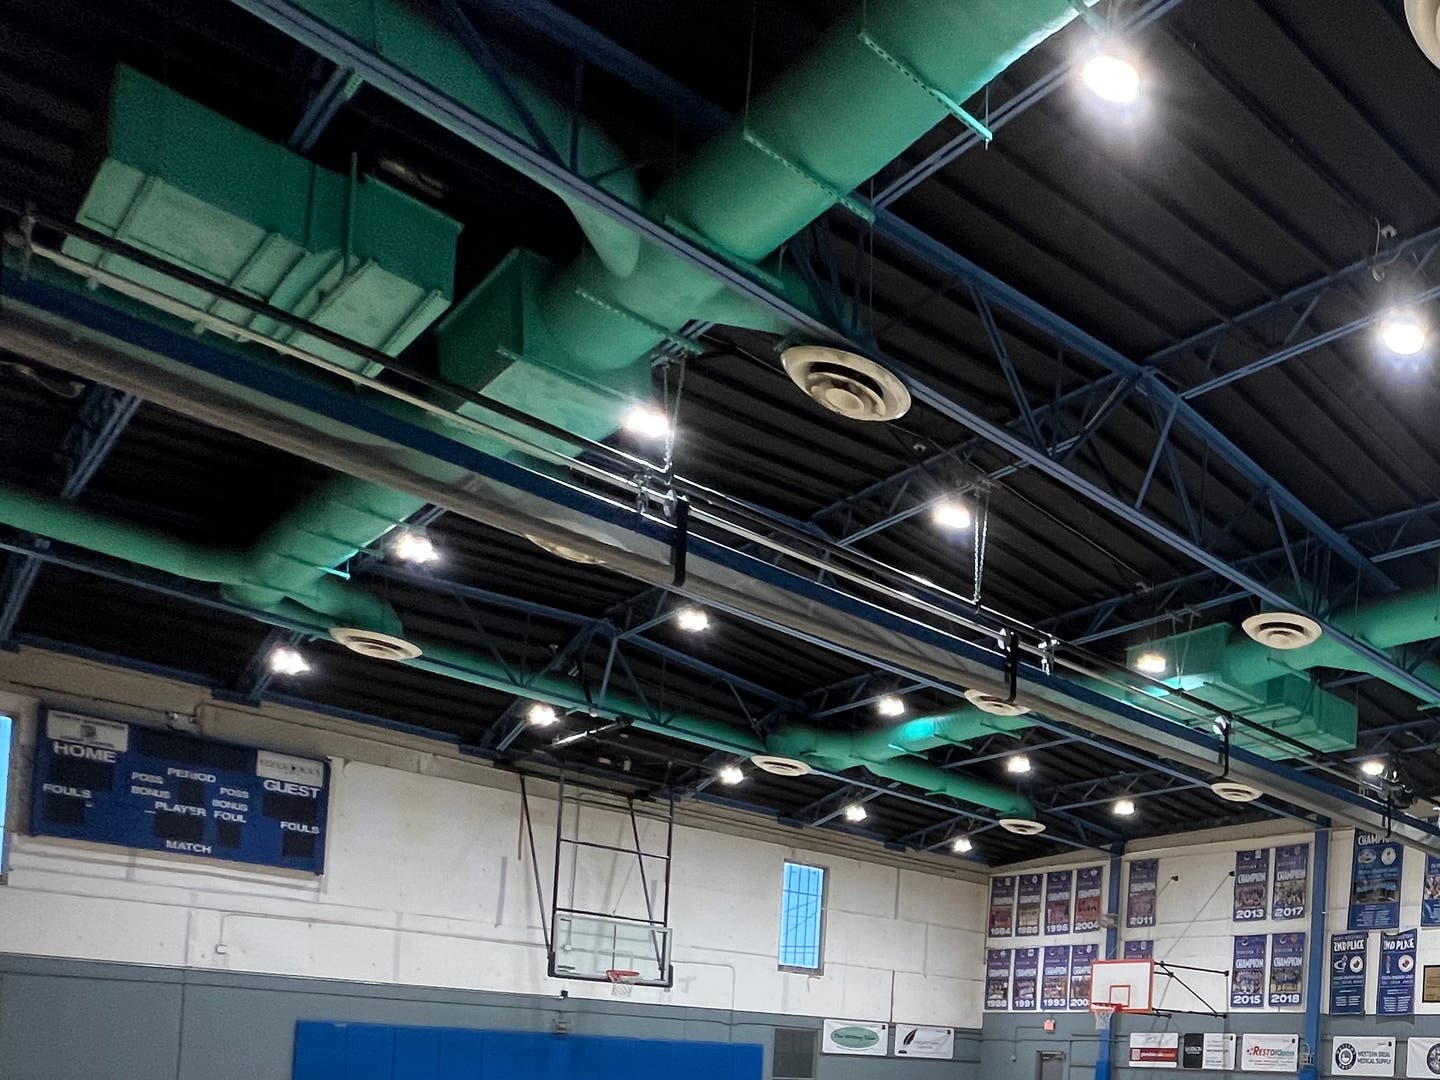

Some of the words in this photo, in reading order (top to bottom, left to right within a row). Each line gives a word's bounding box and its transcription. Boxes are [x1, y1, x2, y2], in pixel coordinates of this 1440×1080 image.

[53, 741, 117, 763] HOME
[131, 772, 163, 784] POSS
[167, 767, 216, 783] PERIOD
[42, 783, 92, 799] FOULS
[131, 785, 170, 799] BONUS
[220, 787, 249, 799] POSS
[263, 779, 320, 799] GUEST
[155, 801, 207, 817] PLAYER
[212, 799, 248, 811] BONUS
[214, 811, 247, 823] FOUL
[280, 821, 320, 834] FOULS
[166, 840, 212, 854] MATCH
[1236, 909, 1264, 919] 2013
[1274, 907, 1303, 917] 2017
[1129, 916, 1153, 925] 2011
[1346, 940, 1364, 950] PLACE
[1396, 938, 1415, 949] PLACE
[1015, 1000, 1035, 1008] 1991
[1043, 998, 1065, 1007] 1993
[1070, 998, 1089, 1007] 200
[1233, 995, 1261, 1004] 2015
[1271, 994, 1300, 1003] 2018
